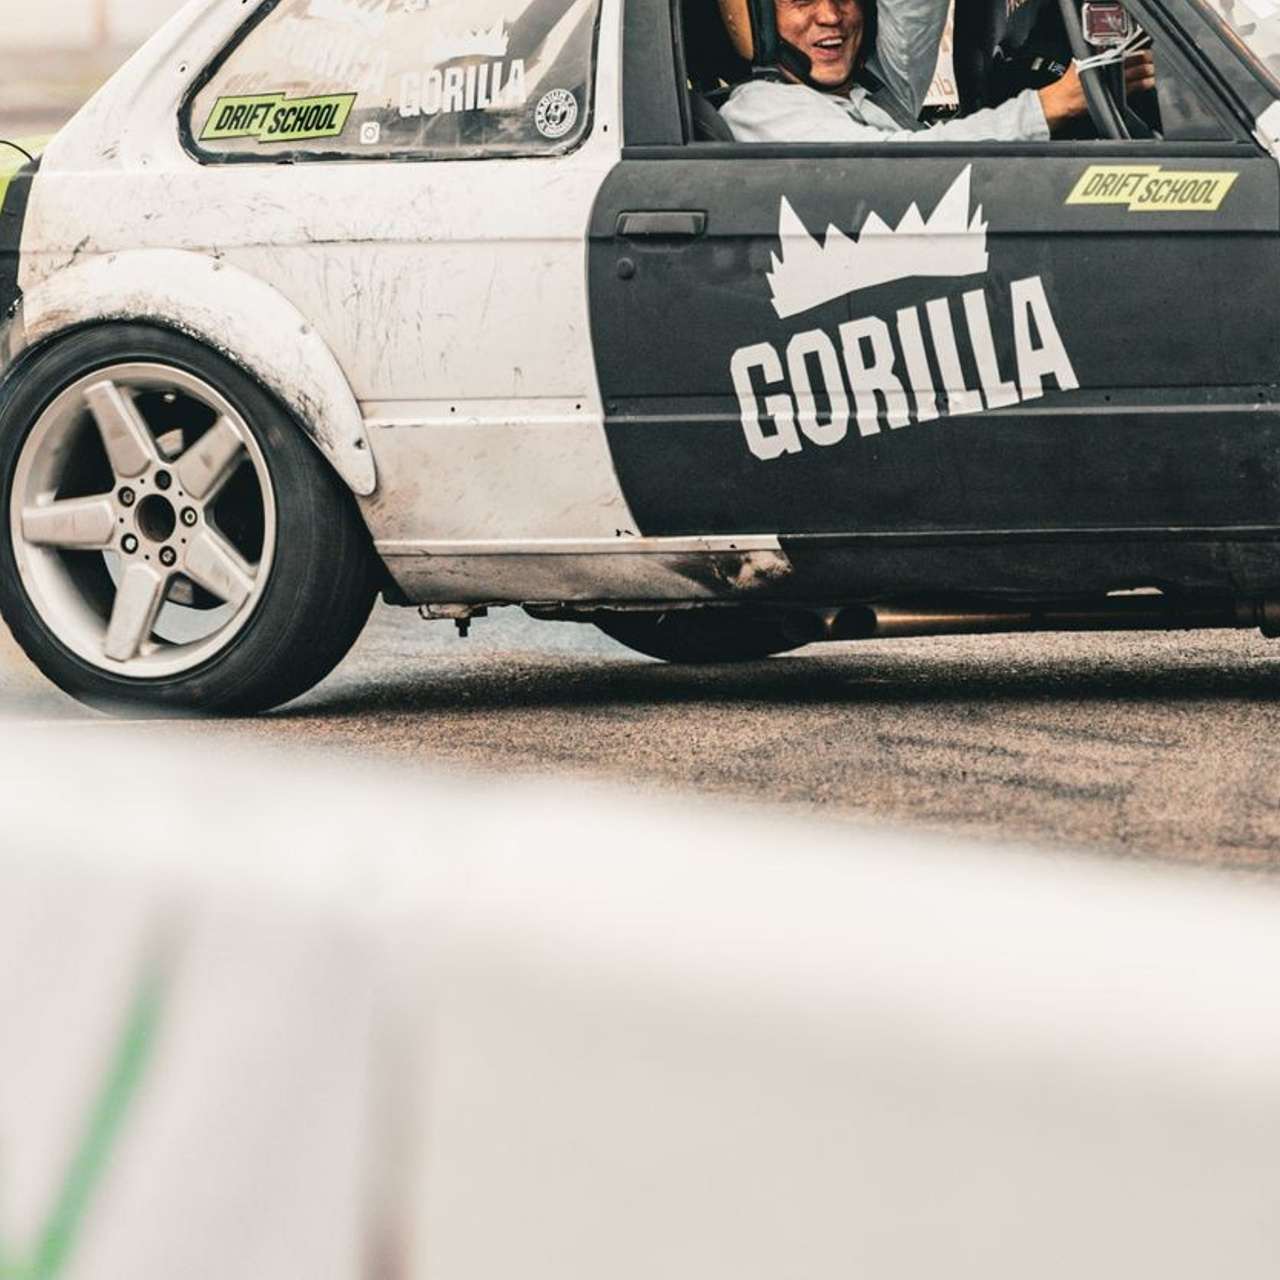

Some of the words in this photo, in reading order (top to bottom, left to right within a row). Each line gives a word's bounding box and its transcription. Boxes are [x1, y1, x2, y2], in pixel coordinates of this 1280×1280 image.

[399, 58, 528, 117] GORILLA
[214, 103, 275, 131] DRIFT
[267, 103, 340, 134] SCHOOL
[1082, 173, 1149, 197] DRIFT
[1138, 179, 1220, 204] SCHOOL
[730, 276, 1080, 461] GORILLA
